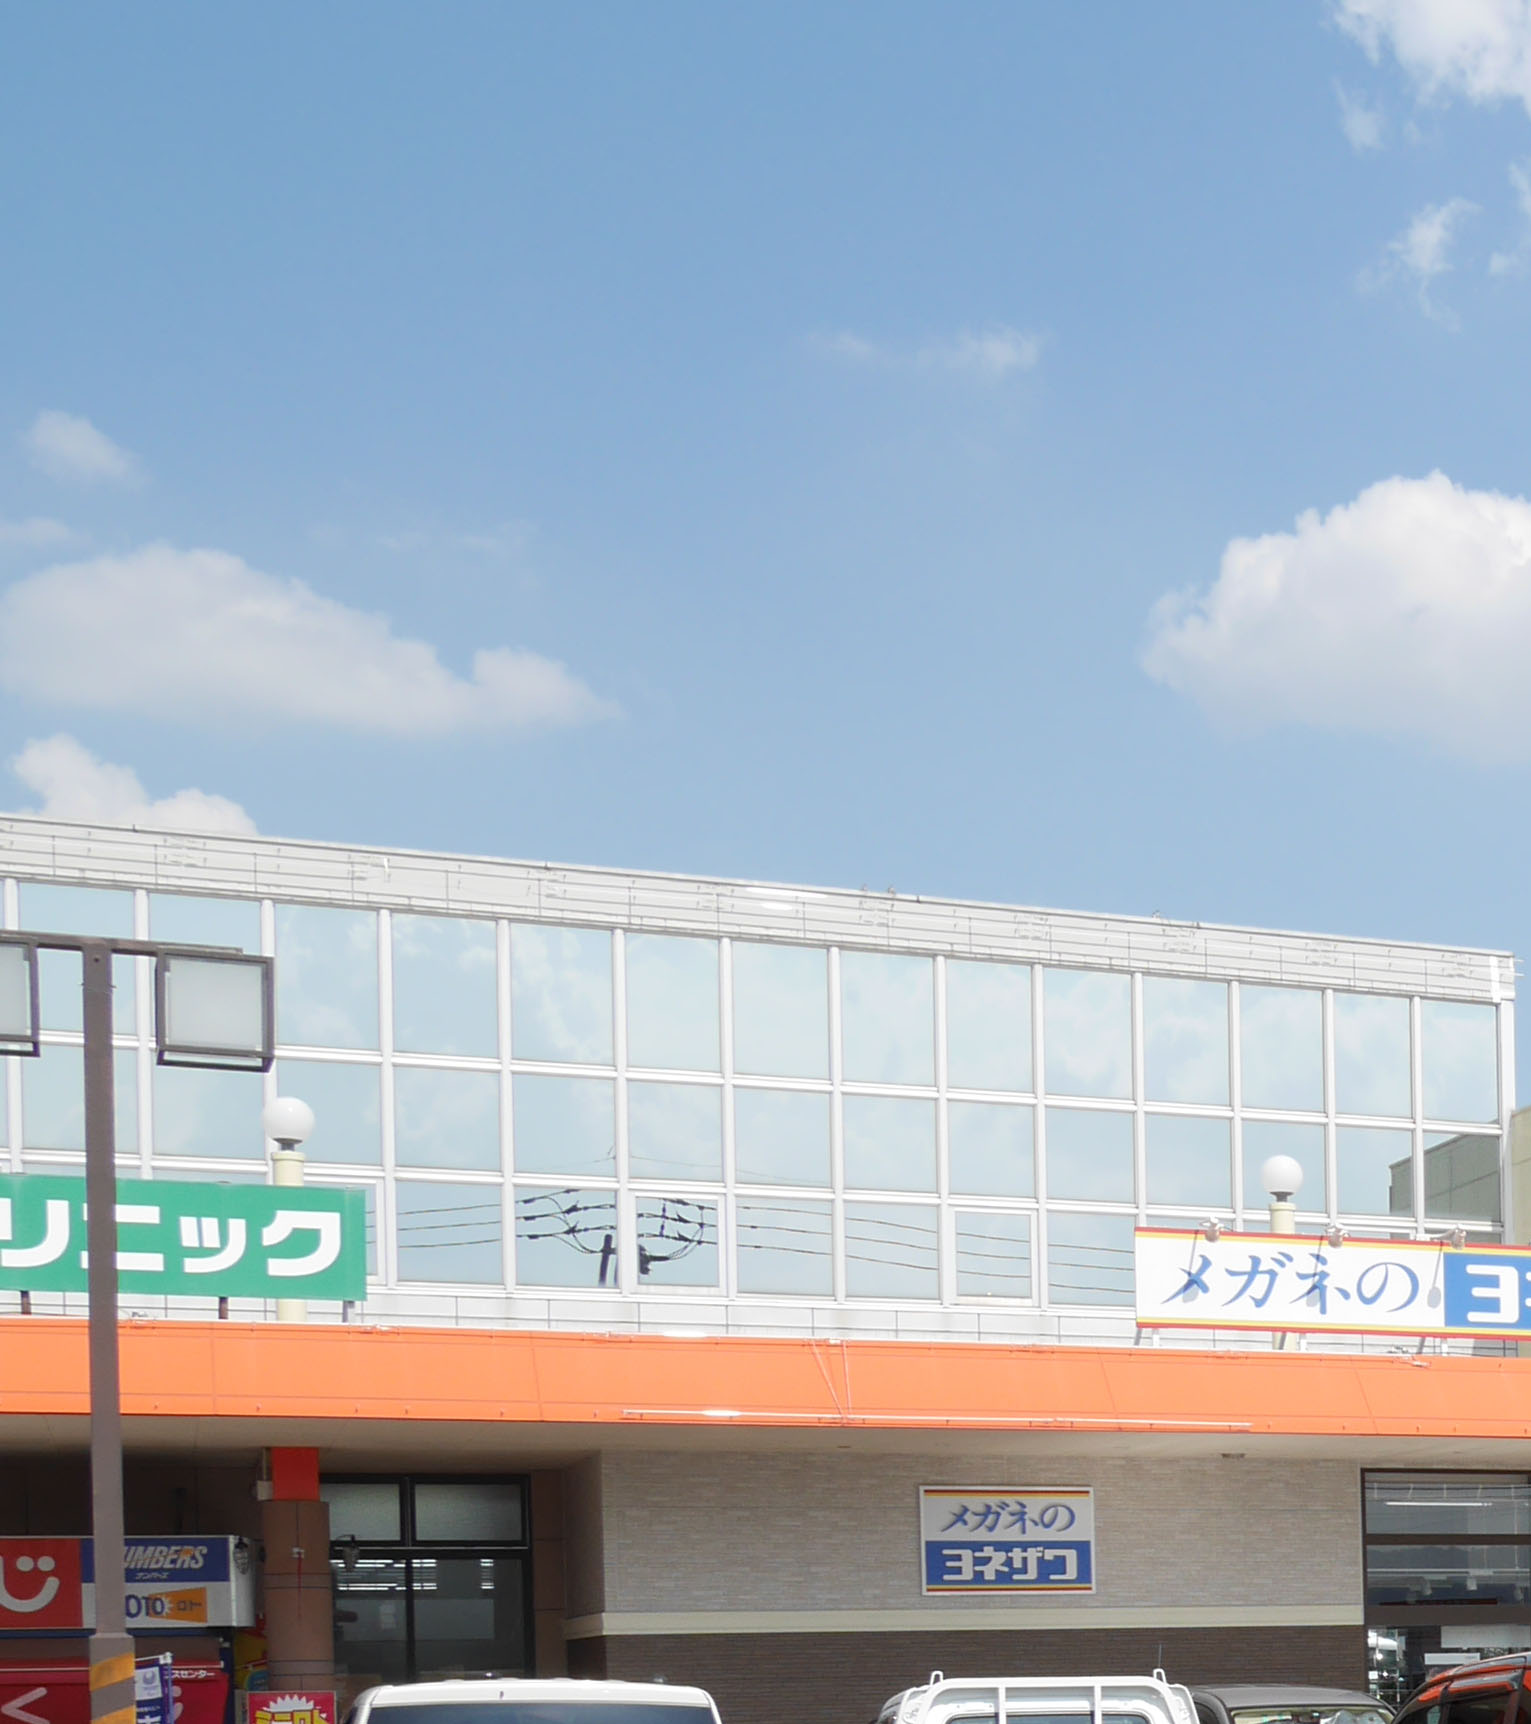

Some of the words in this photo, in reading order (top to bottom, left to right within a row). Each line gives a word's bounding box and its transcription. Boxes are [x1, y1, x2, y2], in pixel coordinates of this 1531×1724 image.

[1160, 1251, 1420, 1316] メガネの
[940, 1500, 1076, 1535] メガネの
[123, 1546, 208, 1570] UMBERS
[942, 1546, 1078, 1581] ヨネザワ
[125, 1594, 166, 1619] OTO
